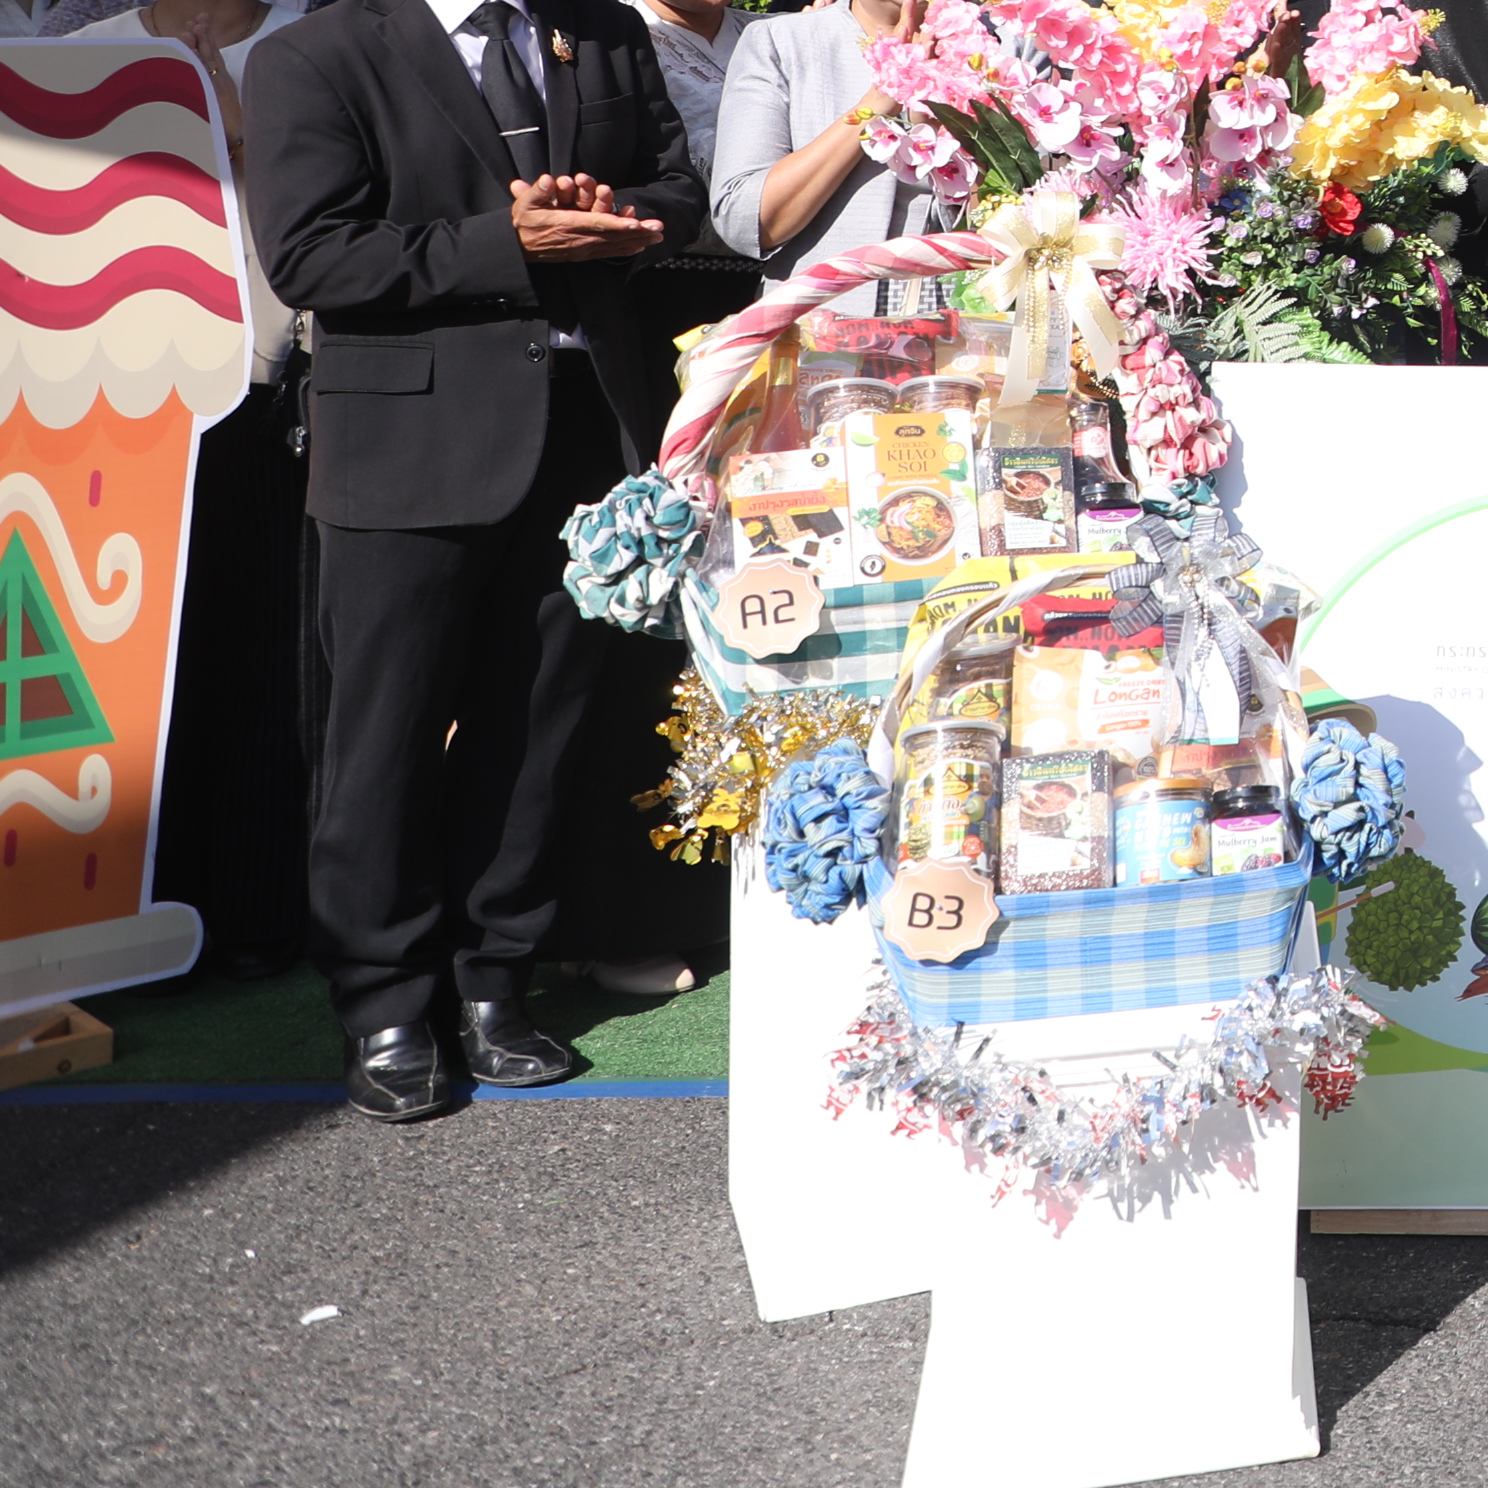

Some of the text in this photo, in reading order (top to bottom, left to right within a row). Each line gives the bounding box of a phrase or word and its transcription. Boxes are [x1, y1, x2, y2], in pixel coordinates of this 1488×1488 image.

[892, 441, 931, 449] CHICKEN
[887, 447, 937, 462] KHAO
[897, 460, 929, 473] SOI
[1087, 526, 1122, 536] Mulberry
[740, 589, 796, 630] A2
[1436, 665, 1479, 673] MINISTRY
[1118, 680, 1146, 688] FREEZE
[1217, 834, 1278, 849] Mulberry Jam
[907, 891, 966, 932] B3
